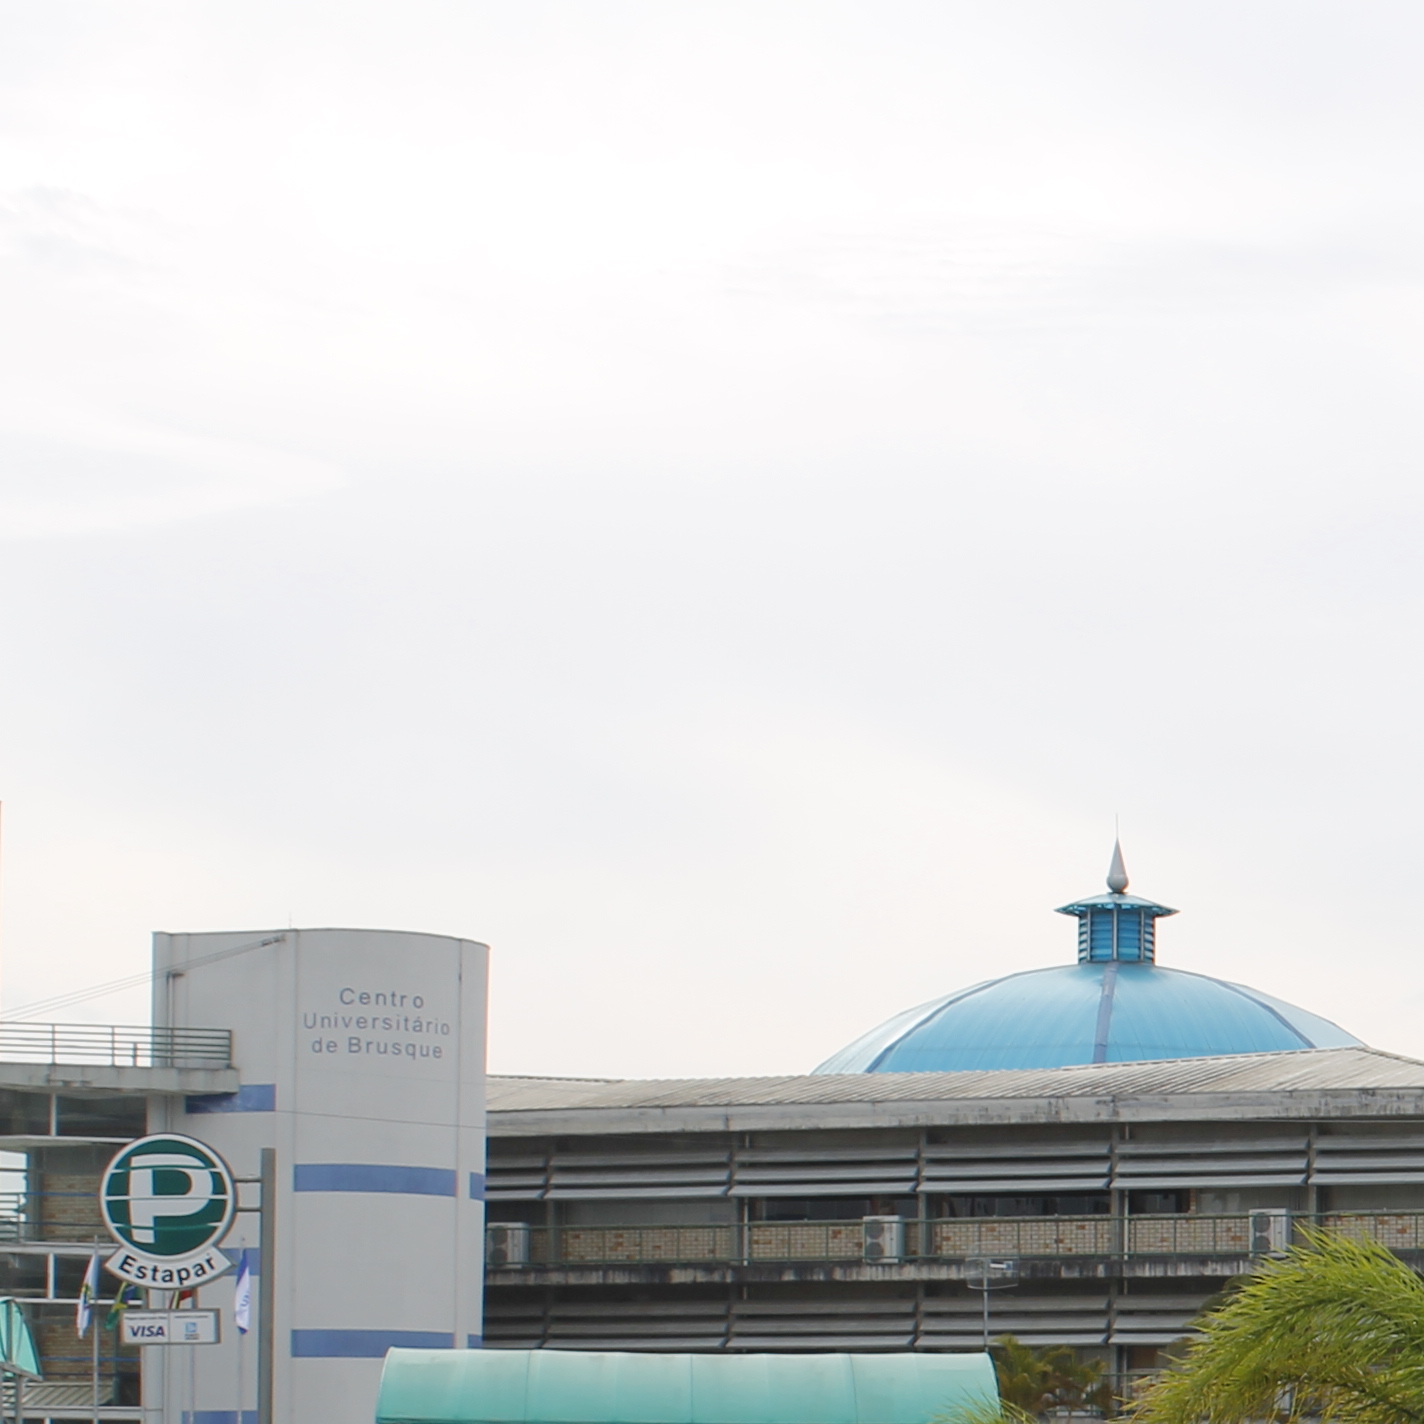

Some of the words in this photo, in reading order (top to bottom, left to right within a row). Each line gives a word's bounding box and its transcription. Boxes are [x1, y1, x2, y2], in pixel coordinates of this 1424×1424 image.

[339, 987, 424, 1009] Centro
[303, 1012, 450, 1036] Universitário
[311, 1037, 338, 1053] de
[347, 1036, 443, 1060] Brusque
[118, 1253, 217, 1286] Estapar
[129, 1325, 166, 1338] VISA
